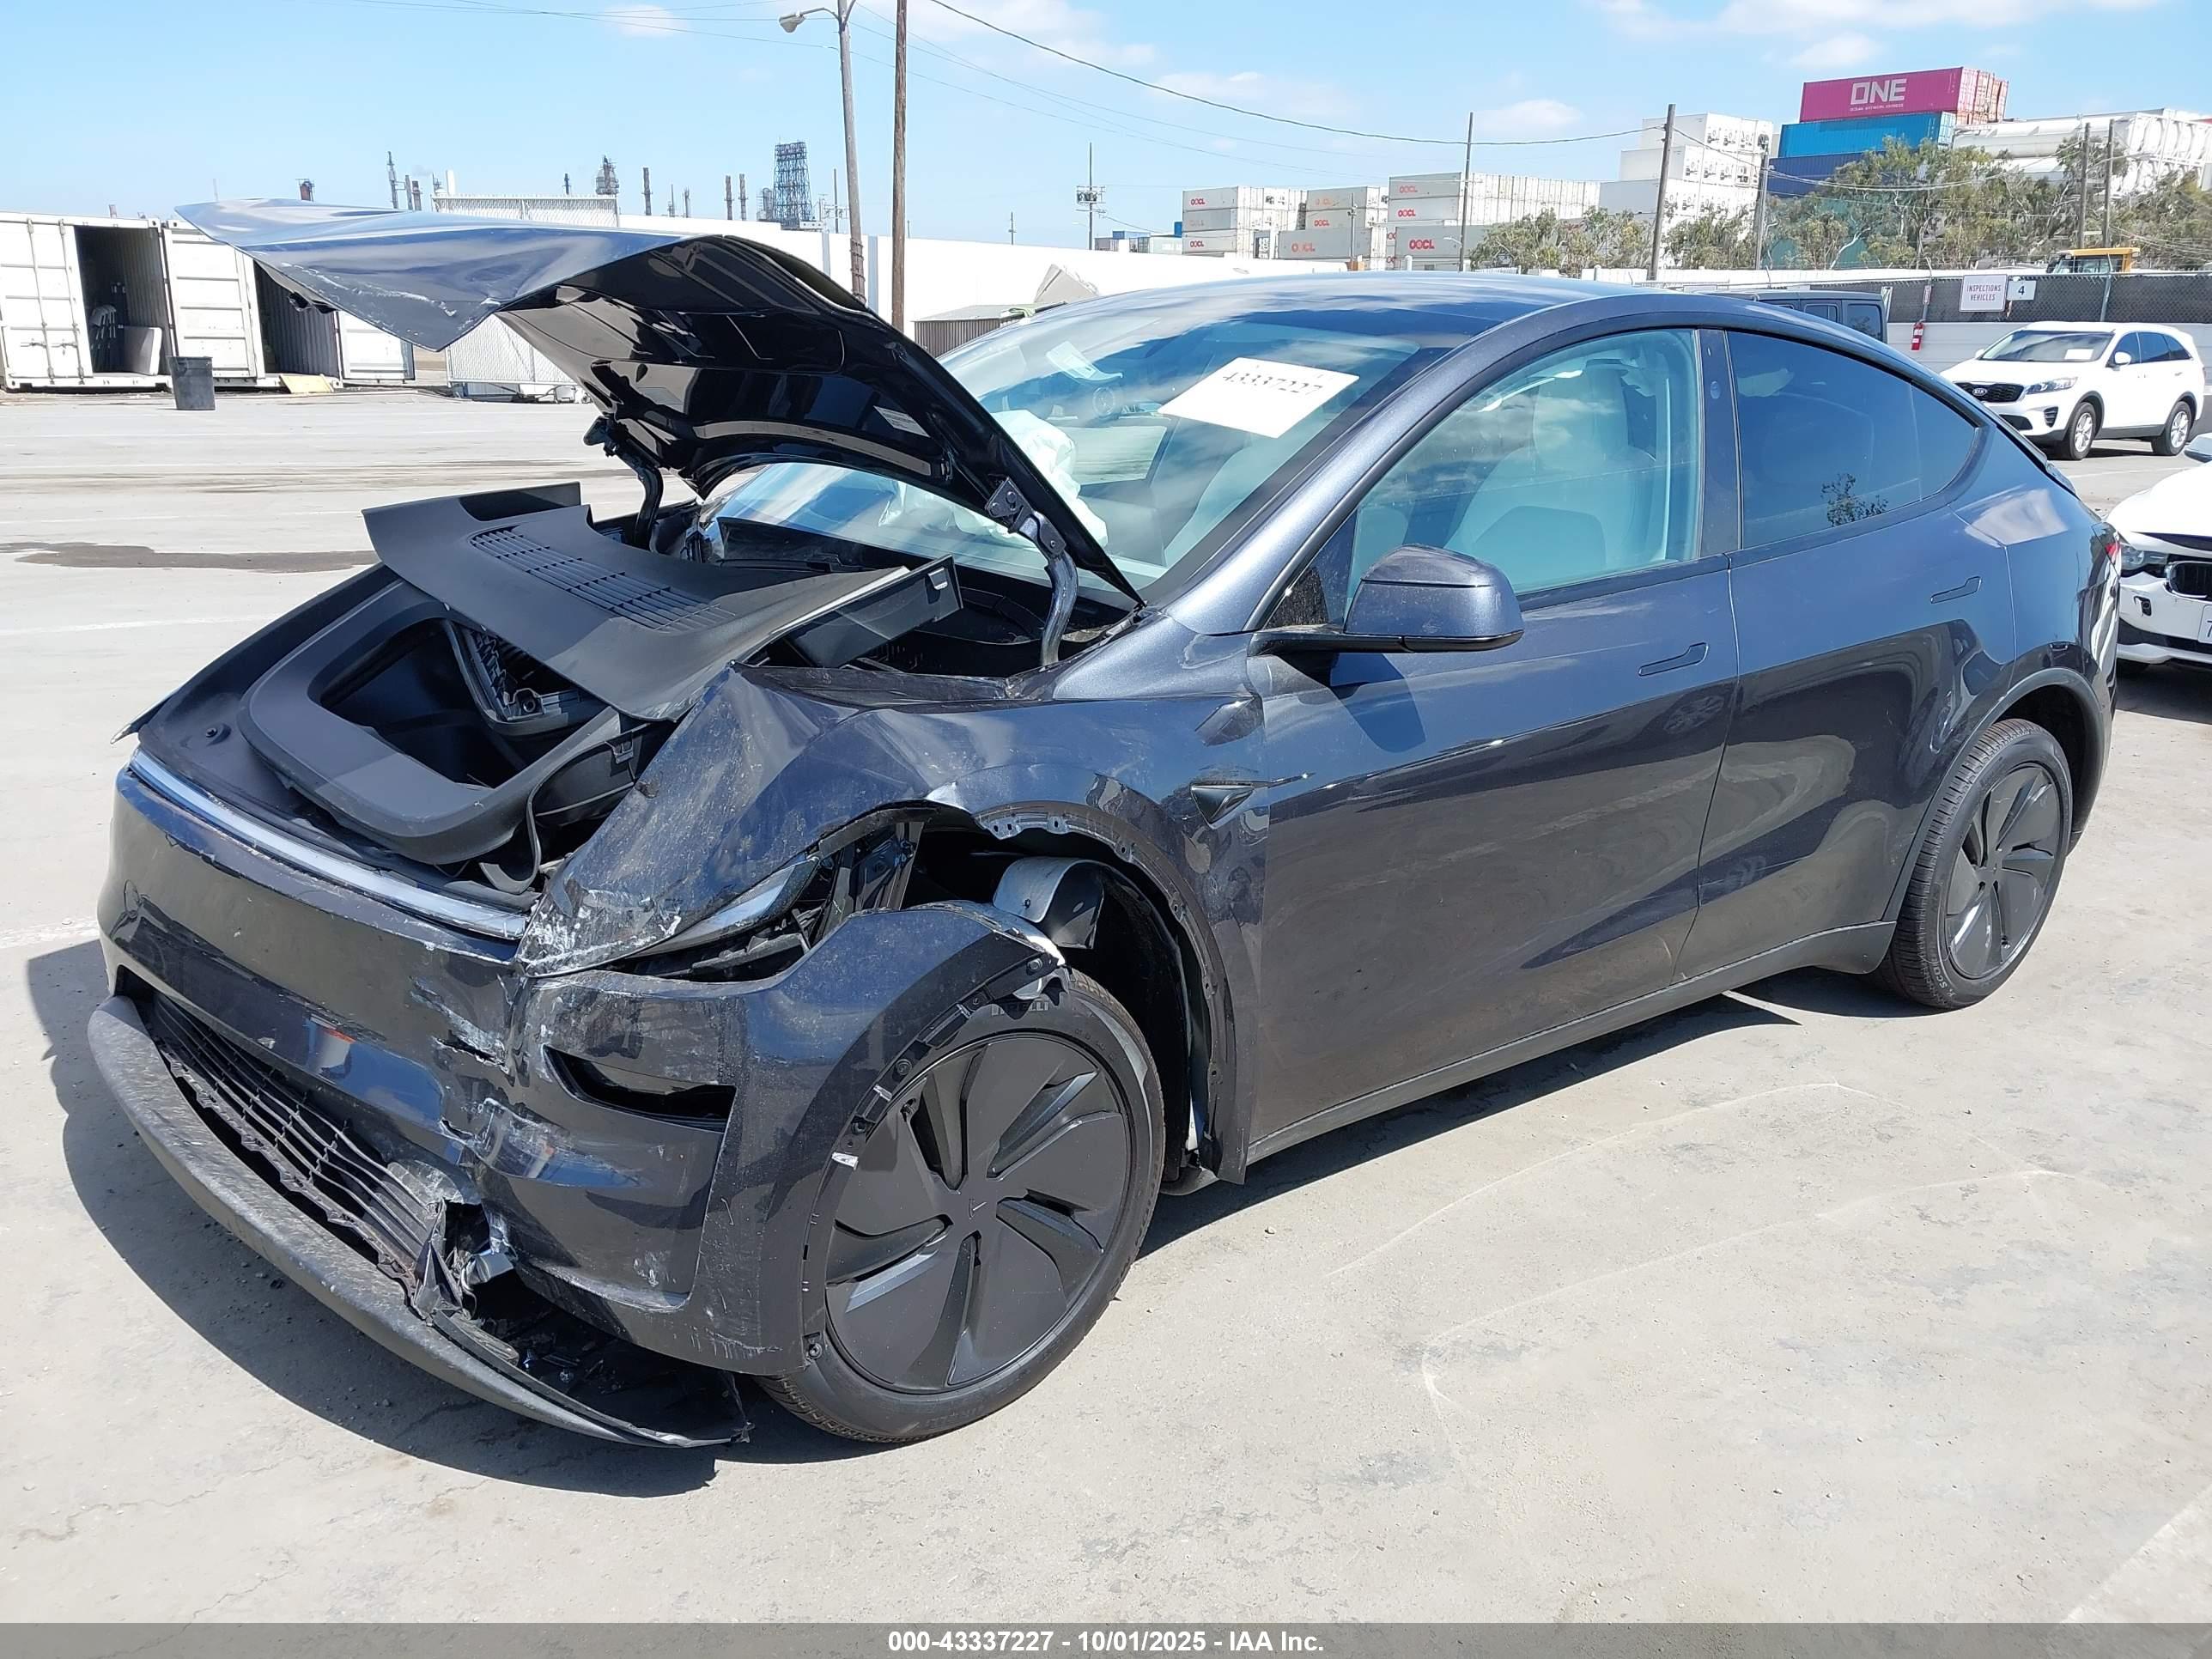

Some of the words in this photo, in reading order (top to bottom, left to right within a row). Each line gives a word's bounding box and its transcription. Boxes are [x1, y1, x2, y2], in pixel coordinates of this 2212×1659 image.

[1850, 78, 1907, 105] ONE
[1397, 209, 1416, 217] OOCL
[1409, 239, 1435, 249] OOCL
[2018, 285, 2025, 295] 4
